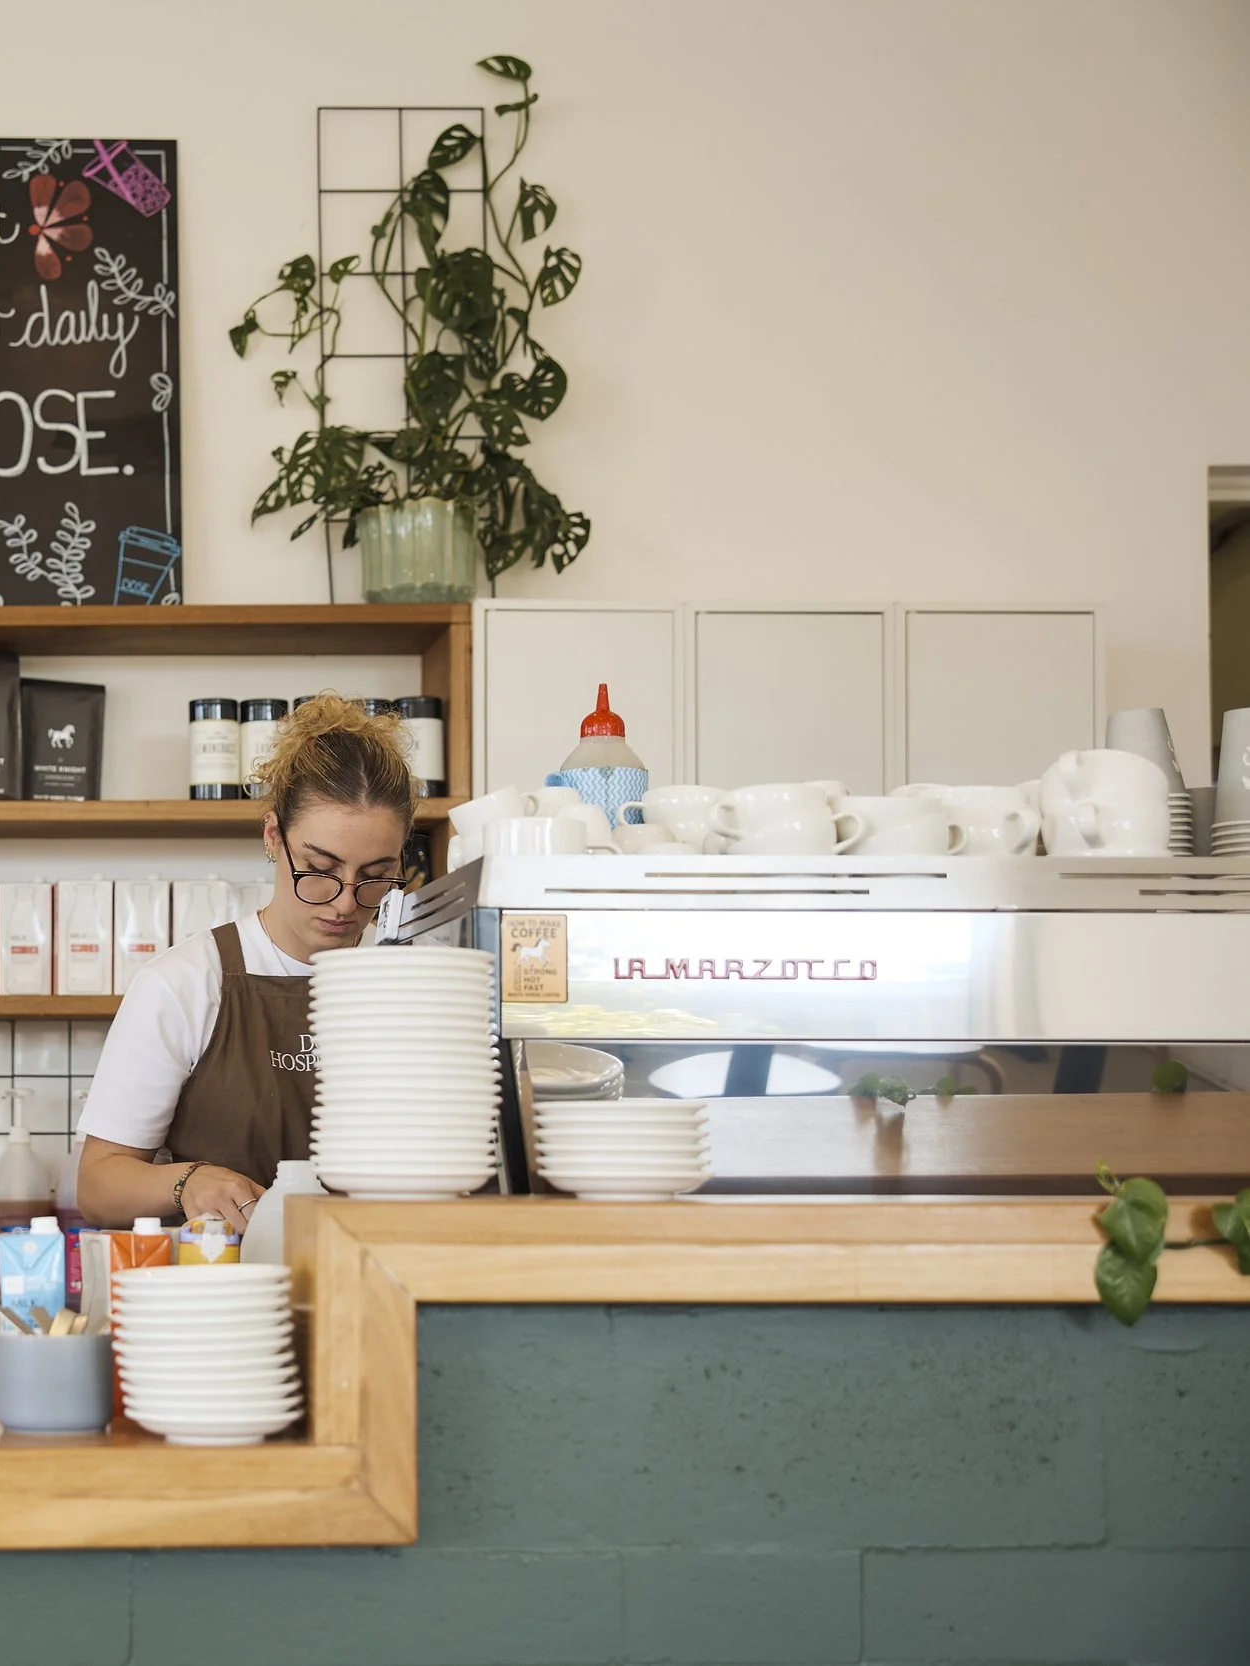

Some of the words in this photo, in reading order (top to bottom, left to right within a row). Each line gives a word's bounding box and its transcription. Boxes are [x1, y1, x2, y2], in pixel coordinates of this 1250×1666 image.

[8, 279, 140, 379] daily
[511, 928, 557, 938] COFFEE
[523, 968, 558, 976] STRONG
[614, 958, 646, 979] LA
